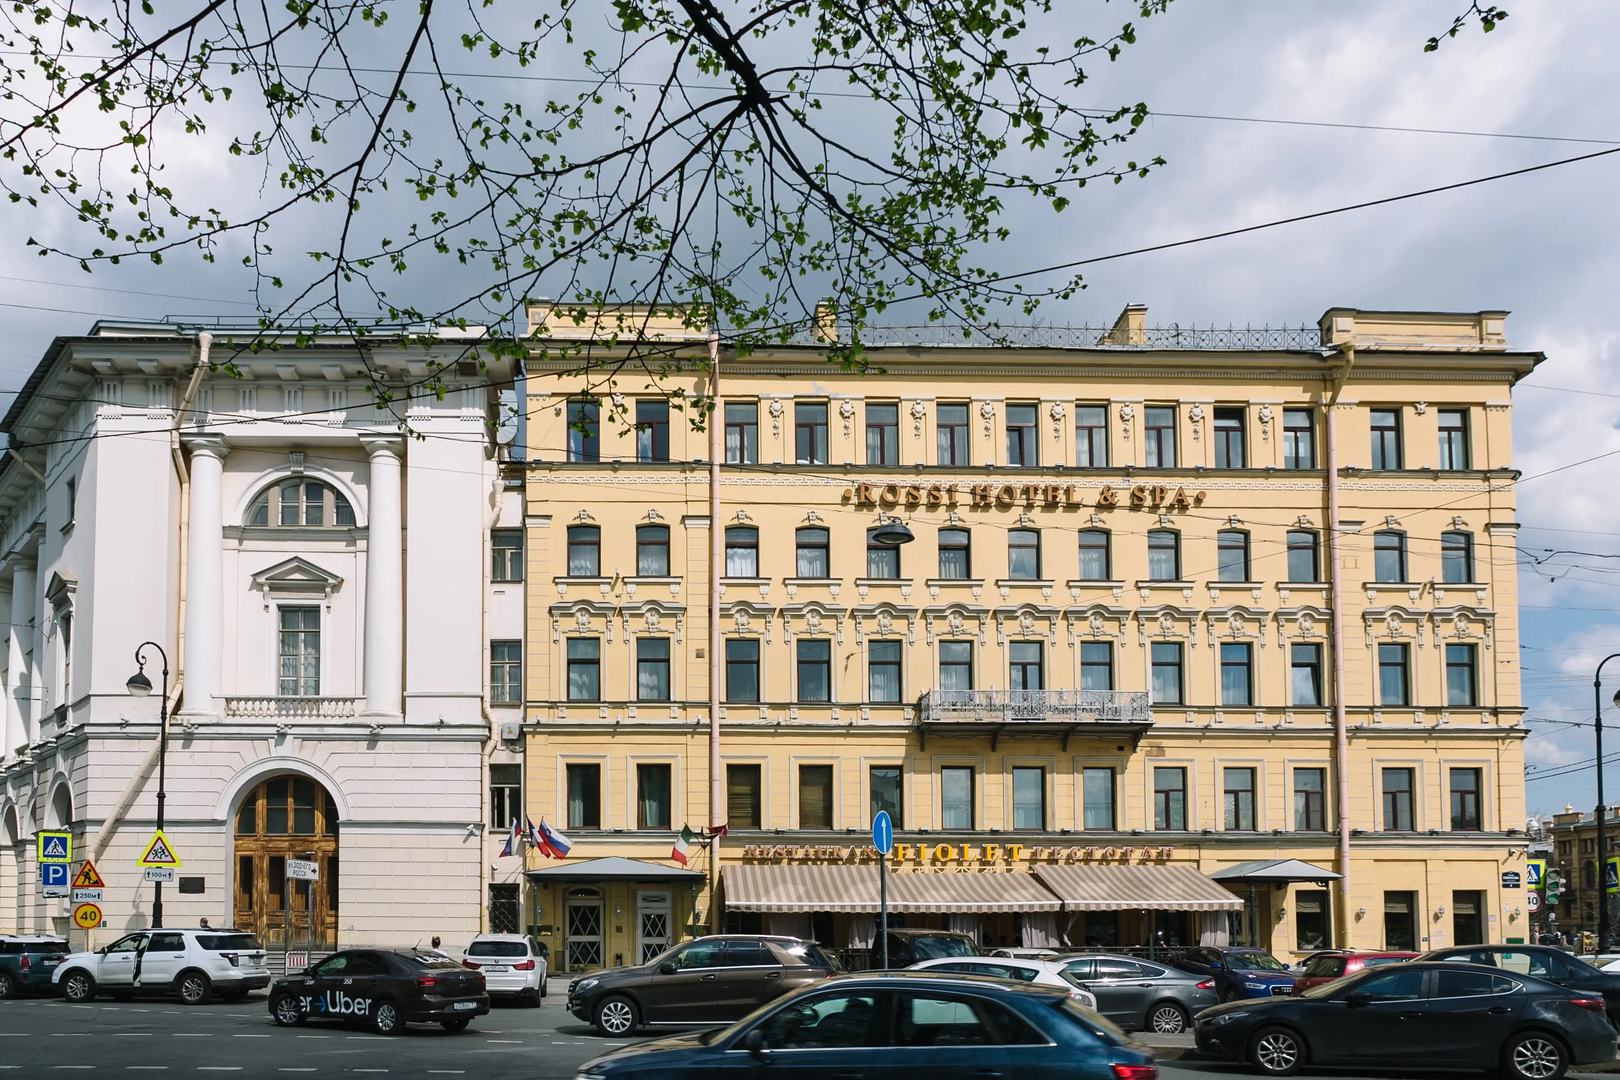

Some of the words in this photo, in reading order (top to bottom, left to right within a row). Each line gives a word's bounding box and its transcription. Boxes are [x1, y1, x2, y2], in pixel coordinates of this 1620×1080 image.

[857, 483, 959, 505] ROSSI
[971, 483, 1084, 506] HOTEL
[1099, 484, 1119, 506] &
[1131, 484, 1191, 507] SPA
[745, 845, 880, 859] RESTAURAN
[894, 843, 1024, 862] FIOLET
[1032, 846, 1175, 860] РЕСТОРАН
[80, 910, 97, 921] 40
[326, 990, 372, 1016] Uber
